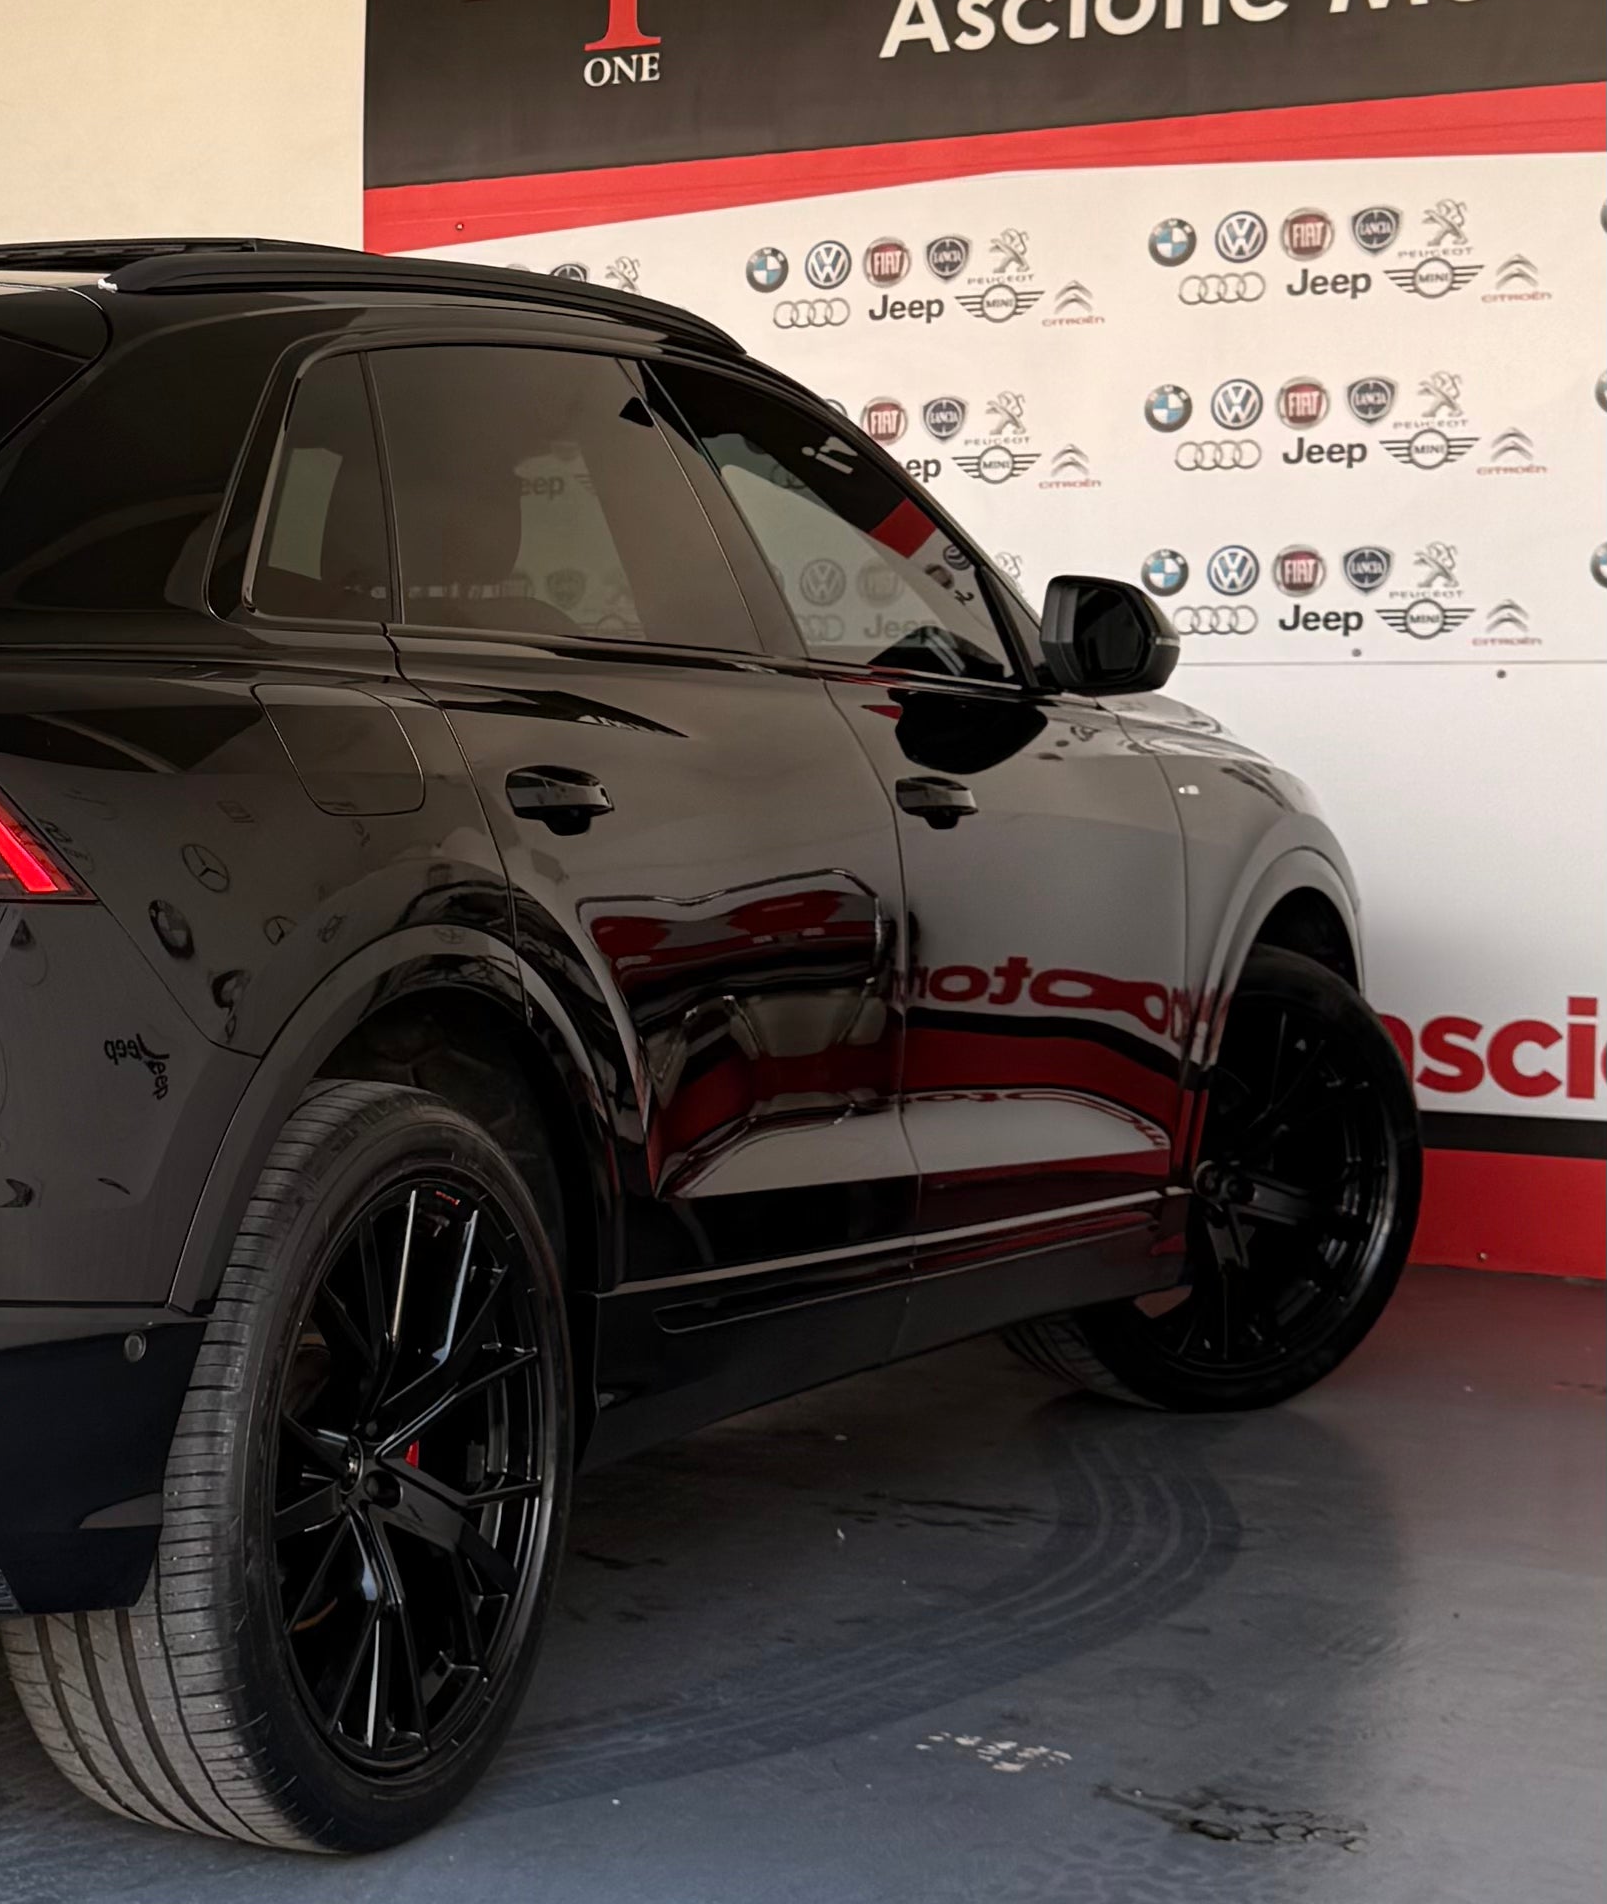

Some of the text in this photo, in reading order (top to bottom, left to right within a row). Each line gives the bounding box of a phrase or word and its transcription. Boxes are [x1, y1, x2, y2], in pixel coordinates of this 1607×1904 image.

[584, 52, 661, 87] ONE
[1292, 222, 1325, 249] FIAT
[874, 250, 903, 276] FIAT
[1286, 268, 1372, 299] Jeep
[869, 294, 944, 324] Jeep
[1288, 391, 1320, 417] FIAT
[870, 410, 899, 434] FIAT
[1282, 436, 1368, 469] Jeep
[898, 459, 941, 483] ep
[1284, 559, 1316, 584] FIAT
[1278, 603, 1364, 637] Jeep
[1378, 995, 1607, 1100] sci
